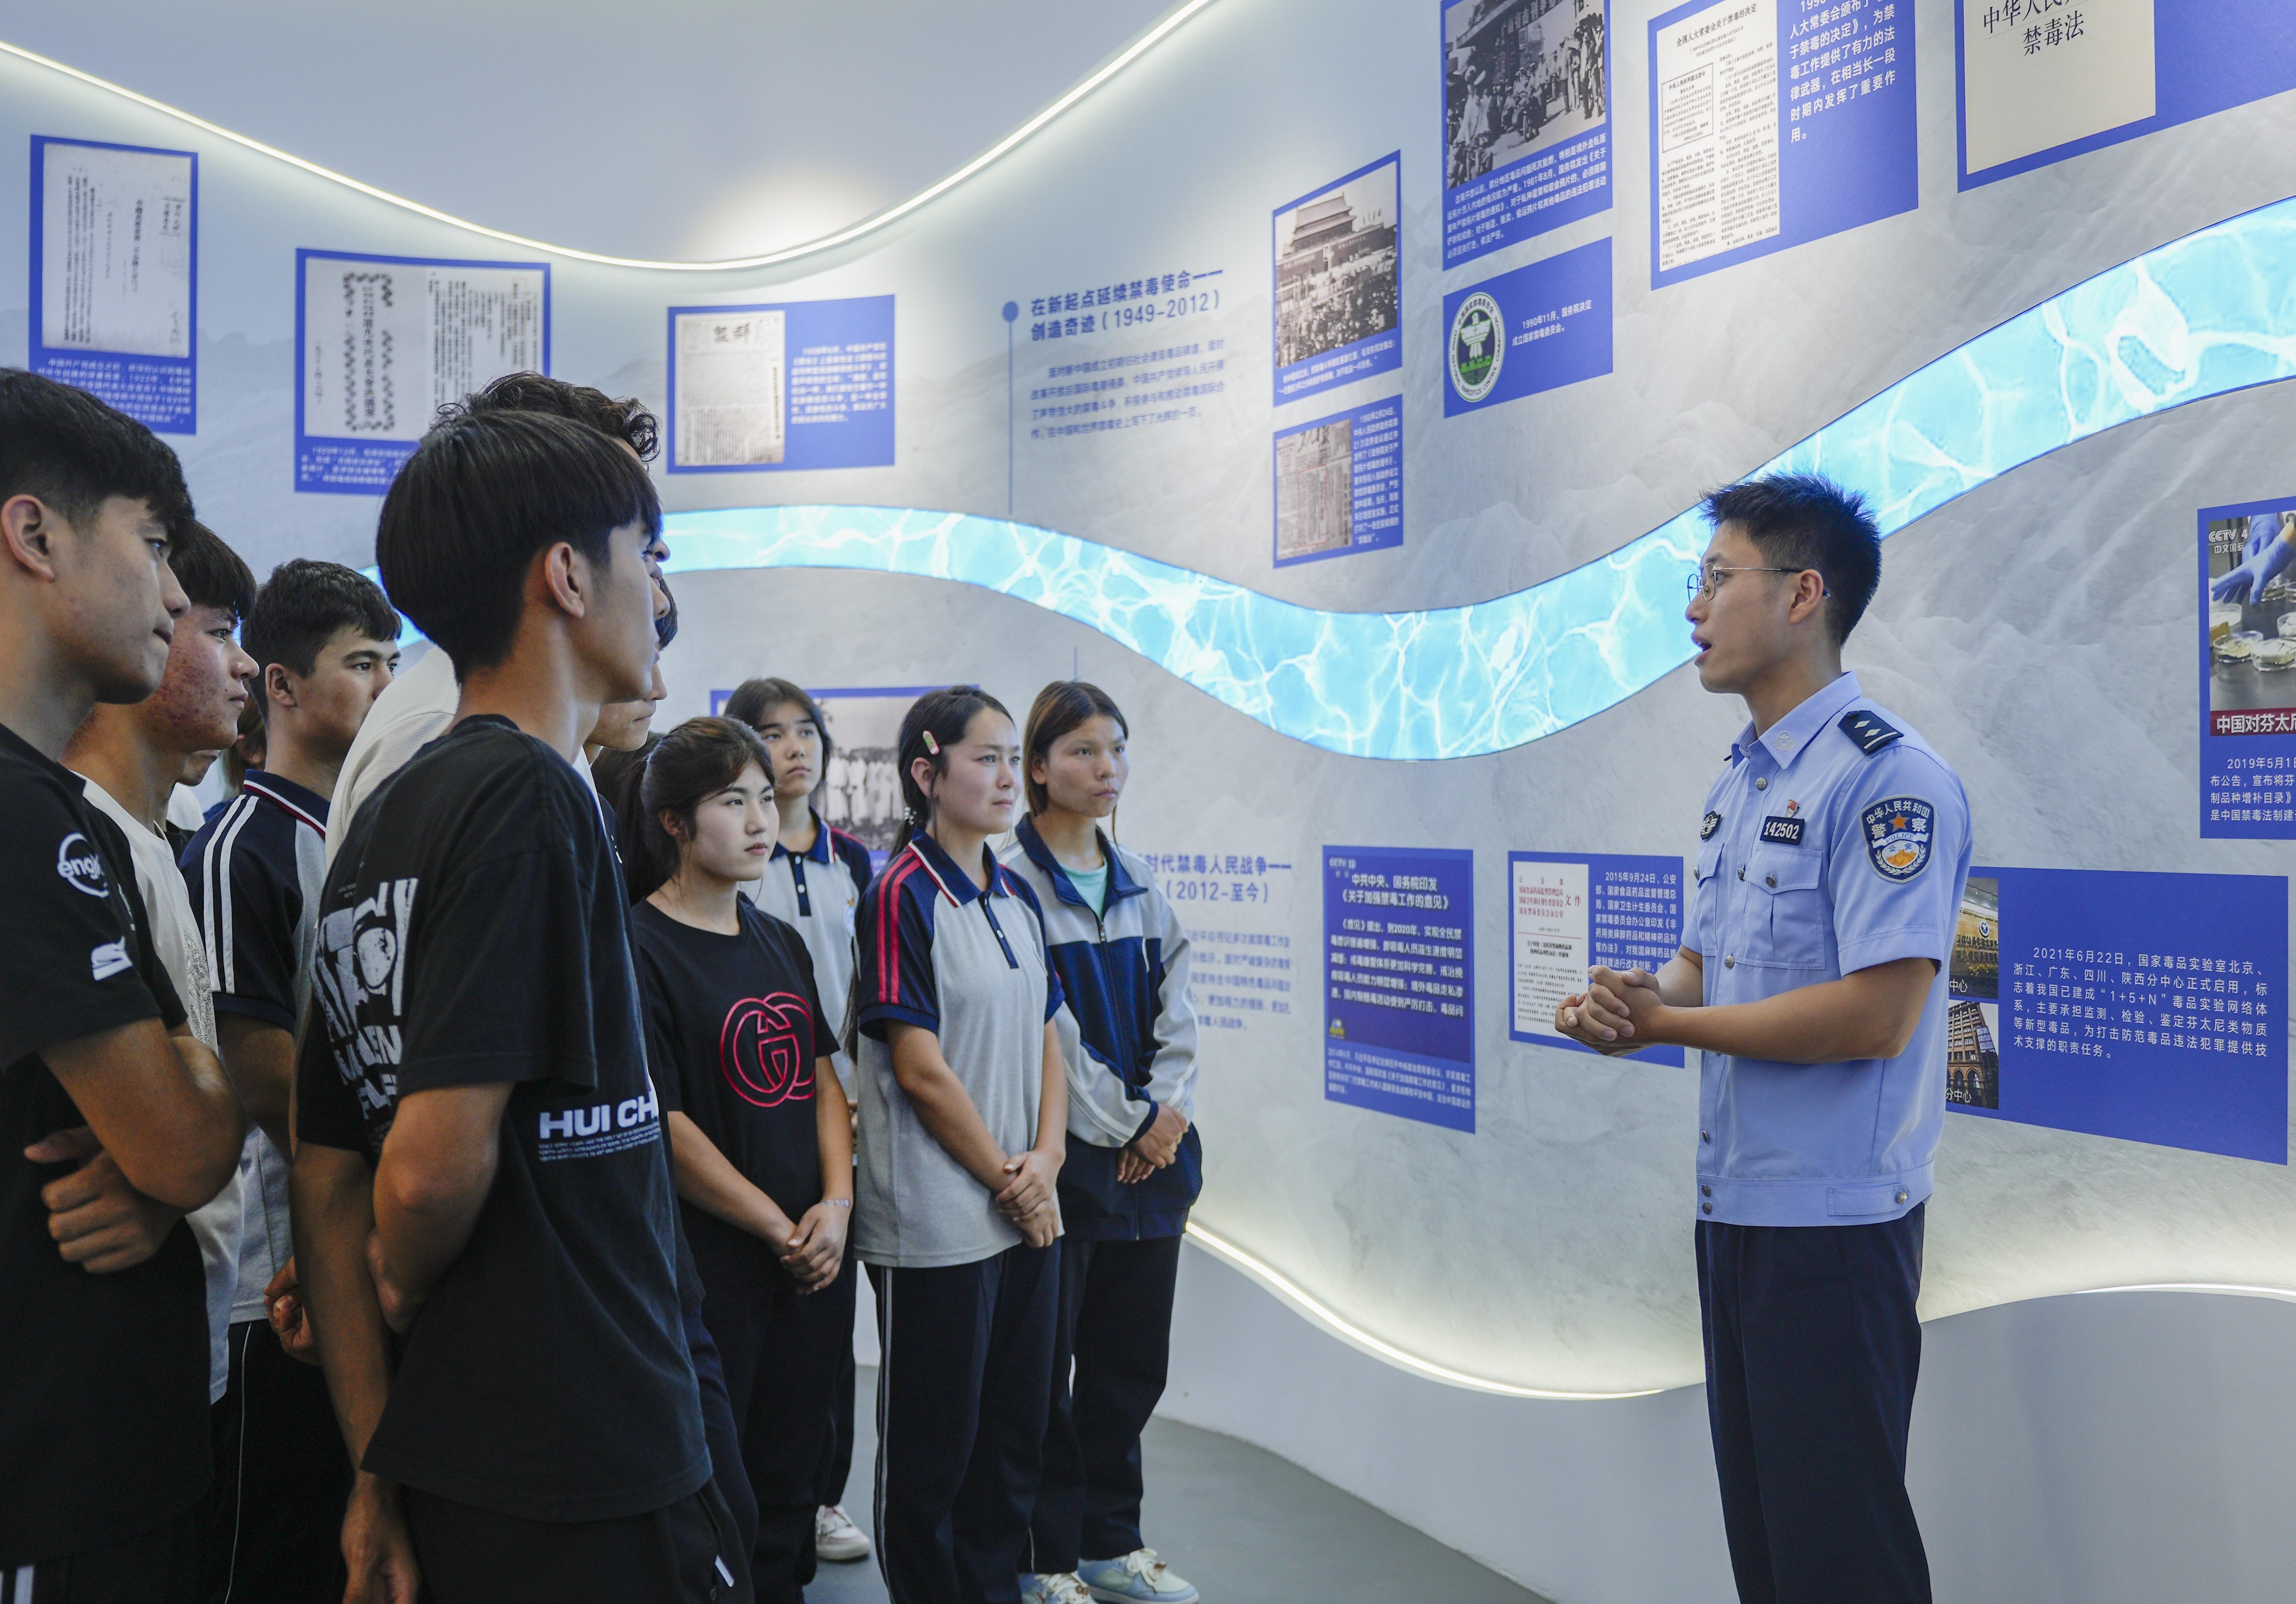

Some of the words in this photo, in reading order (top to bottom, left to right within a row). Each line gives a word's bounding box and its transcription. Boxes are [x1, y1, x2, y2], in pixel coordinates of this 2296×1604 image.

[1676, 3, 1757, 47] 全国人大常委会关于禁毒的决定
[1790, 0, 1883, 39] 人大常委会颁布了
[1983, 0, 2069, 34] 中华人民
[1790, 3, 1894, 59] 于禁毒的决定》，为禁
[2023, 11, 2084, 57] 禁毒法
[1790, 26, 1895, 80] 毒工作提供了有力的法
[1790, 47, 1895, 101] 律武器，在相当长一段
[1791, 70, 1895, 122] 时期内发挥了重要作
[1791, 127, 1806, 143] 用。
[1030, 270, 1223, 317] 在新起点延续禁毒使命——
[1522, 300, 1591, 329] 1990年11月，国务院决定
[1512, 325, 1565, 347] 成立国家禁毒委员会。
[2208, 528, 2236, 542] CCTV
[2241, 529, 2248, 538] 4
[2210, 775, 2296, 787] 布公告，宣布将芬
[2210, 791, 2291, 804] 制品种增补目录》
[1866, 801, 1930, 824] 中华人民共和国
[2210, 809, 2296, 821] 是中国禁毒法制建
[1763, 821, 1800, 840] 142502
[1885, 833, 1914, 843] POLICE
[1889, 843, 1912, 852] 公安
[1137, 853, 1292, 875] 时代禁毒人民战争——
[1329, 857, 1346, 868] CCTV
[1348, 859, 1356, 869] 13
[1351, 874, 1437, 892] 中共中央、国务院印发
[1605, 872, 1676, 885] 2015年9月24日，公安
[1341, 889, 1449, 910] 《关于加强禁毒工作的意见》
[1519, 886, 1563, 896] 国家食品药品监督管理总局
[1565, 894, 1581, 907] 文件
[1595, 885, 1676, 900] 部、国家食品药品监督管理总
[1519, 896, 1563, 907] 国家卫生和计划生育委员会
[1595, 900, 1676, 915] 局、国家卫生计生委员会、国
[1519, 907, 1563, 918] 国家禁毒委员会办公室
[1595, 914, 1676, 929] 家禁毒委员会办公室印发《非
[1595, 928, 1676, 944] 药用类麻醉药品和精神药品列
[1595, 942, 1676, 958] 管办法》，对我国麻精药品管
[2033, 948, 2264, 976] 2021年6月22日，国家毒品实验室北京、
[1949, 979, 1968, 993] 中心
[2013, 963, 2268, 996] 浙江、广东、四川、陕西分中心正式启用，标
[2013, 981, 2268, 1016] 志着我国已建成“1+5+N”毒品实验网络体
[2013, 999, 2268, 1037] 系，主要承担监测、检验、鉴定芬太尼类物质
[2013, 1017, 2267, 1057] 等新型毒品，为打击防范毒品违法犯罪提供技
[2013, 1035, 2112, 1058] 术支撑的职责任务。
[539, 1105, 611, 1140] HUI
